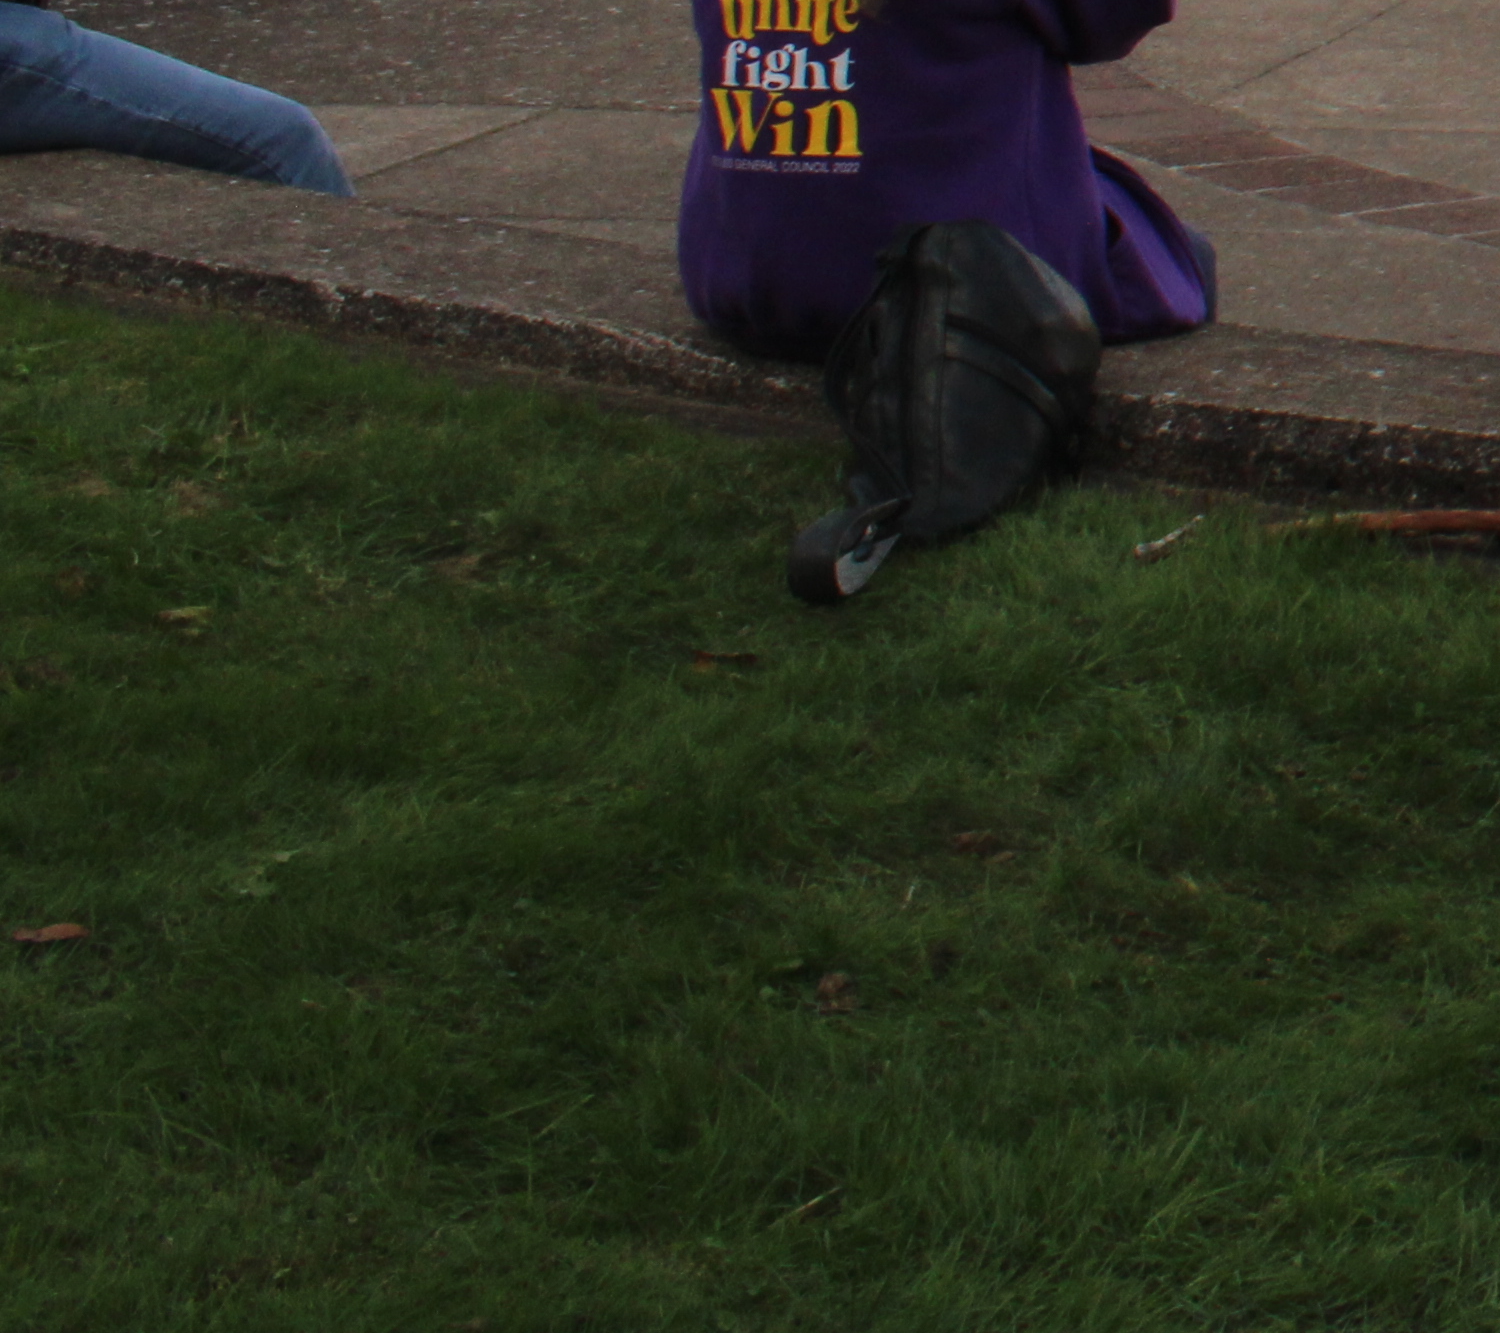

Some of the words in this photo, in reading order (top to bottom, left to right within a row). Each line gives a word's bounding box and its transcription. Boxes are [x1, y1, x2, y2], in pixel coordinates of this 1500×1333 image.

[720, 40, 855, 92] fight
[711, 88, 863, 157] Win
[734, 159, 778, 172] GENERAL
[781, 161, 829, 173] COUNCIL
[832, 161, 861, 173] 2022
